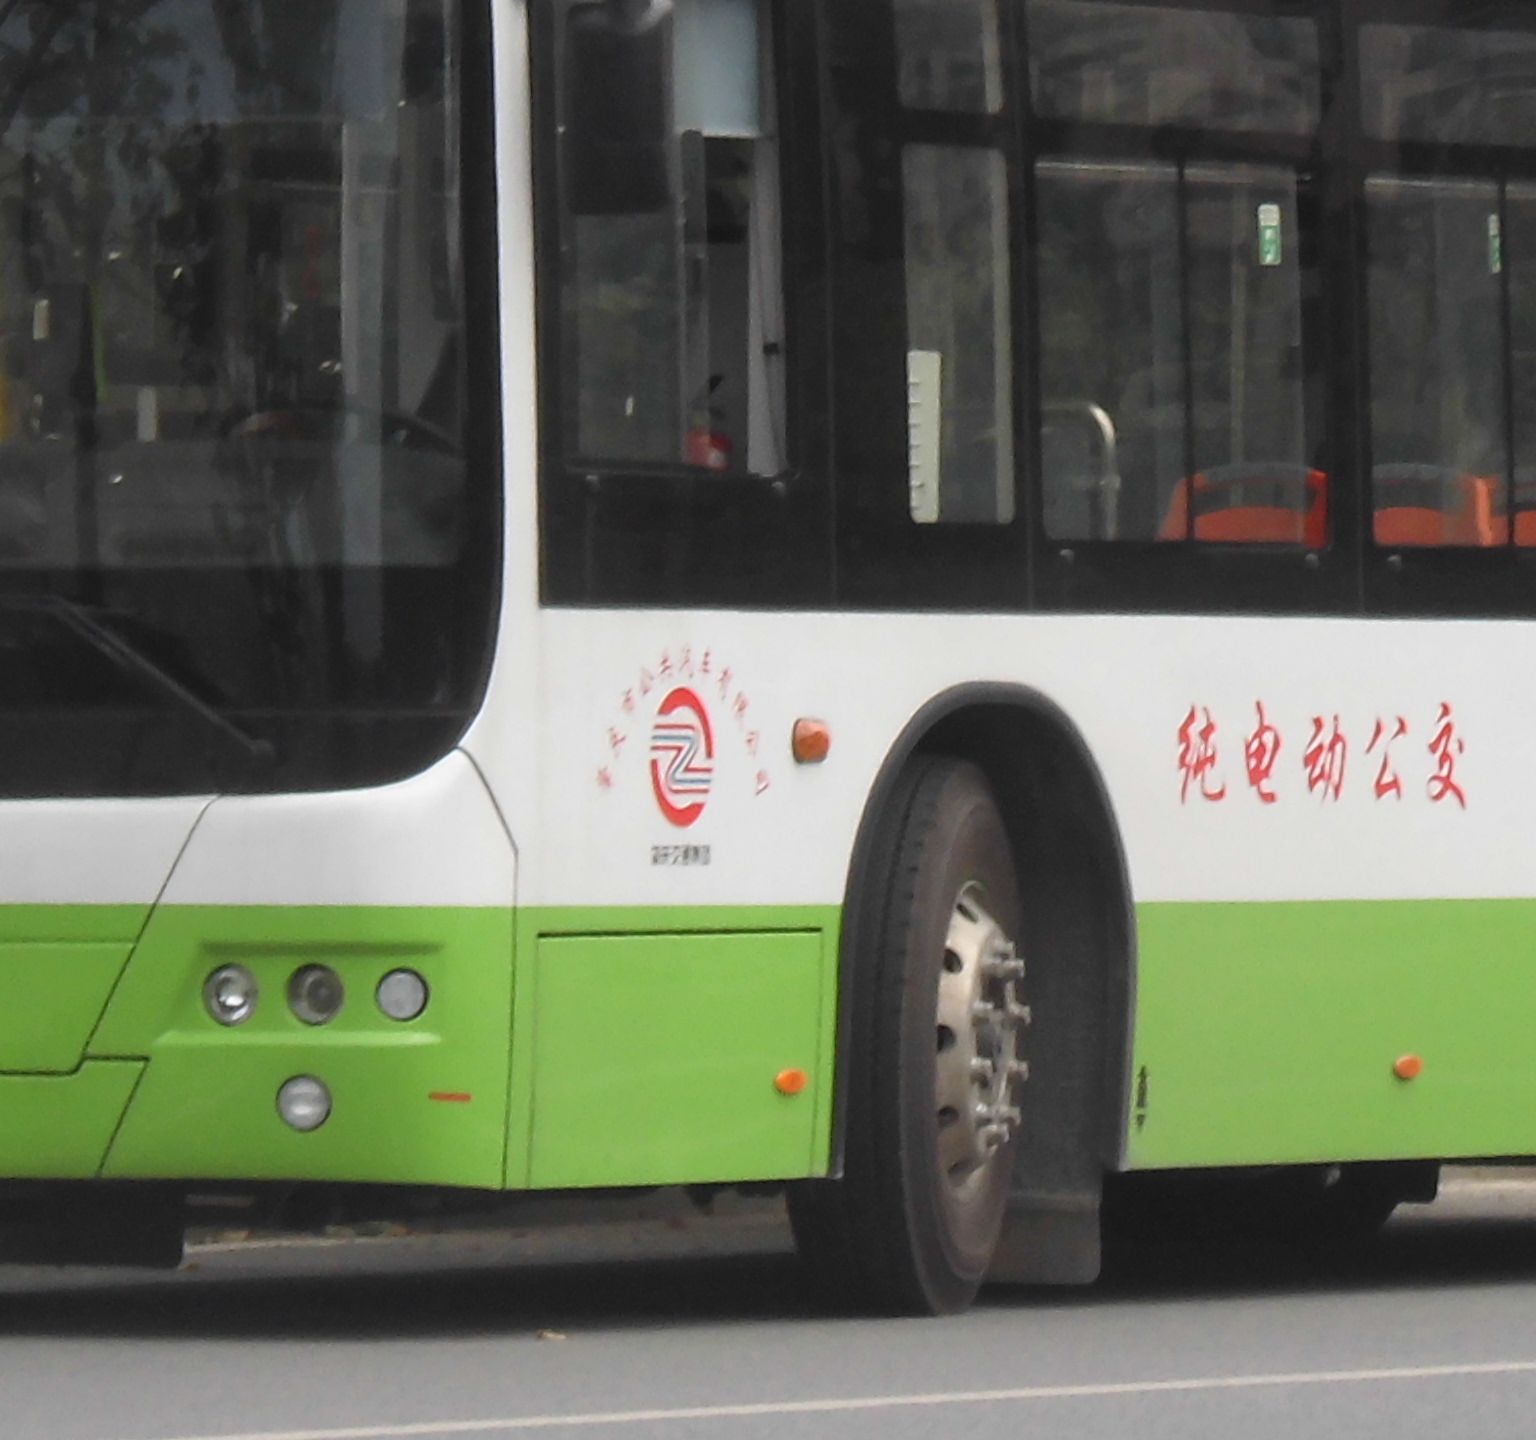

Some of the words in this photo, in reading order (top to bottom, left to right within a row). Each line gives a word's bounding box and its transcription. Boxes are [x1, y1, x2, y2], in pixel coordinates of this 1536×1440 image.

[1176, 699, 1467, 810] 纯电动公交
